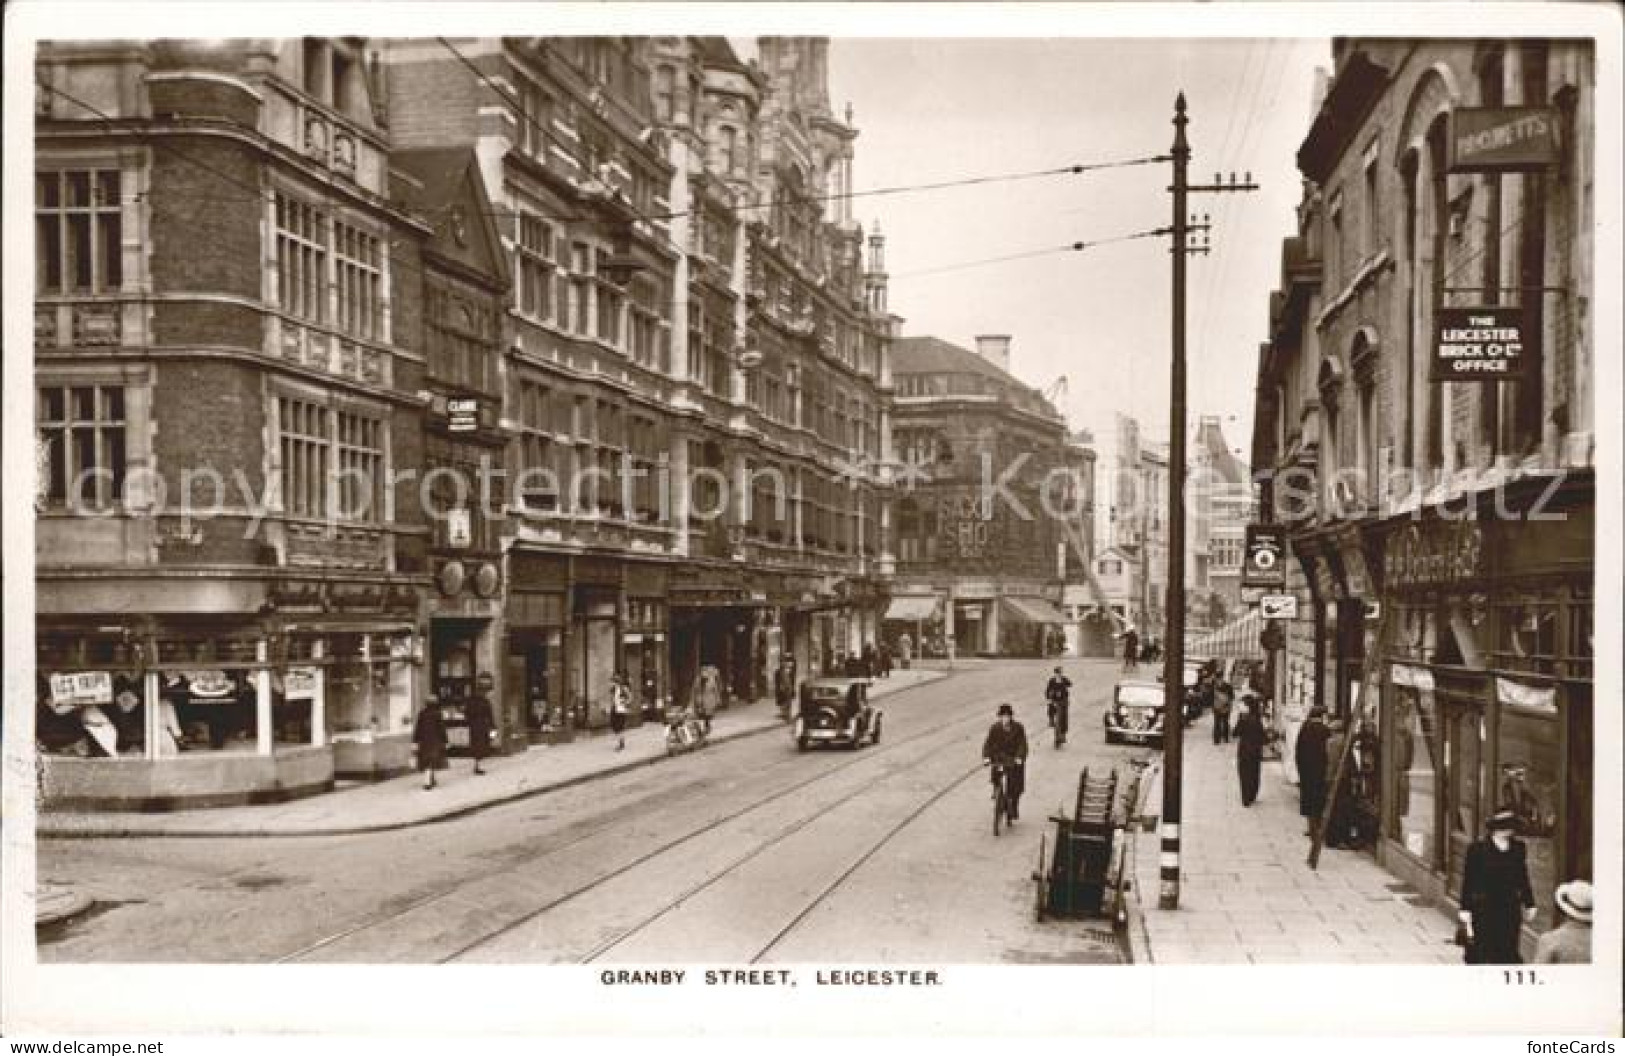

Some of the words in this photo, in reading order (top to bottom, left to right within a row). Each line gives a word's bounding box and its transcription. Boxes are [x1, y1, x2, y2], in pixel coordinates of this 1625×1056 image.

[1469, 316, 1496, 326] THE
[1442, 328, 1519, 341] LEICESTER
[1439, 344, 1483, 357] BRICK
[1453, 359, 1508, 372] OFFICE
